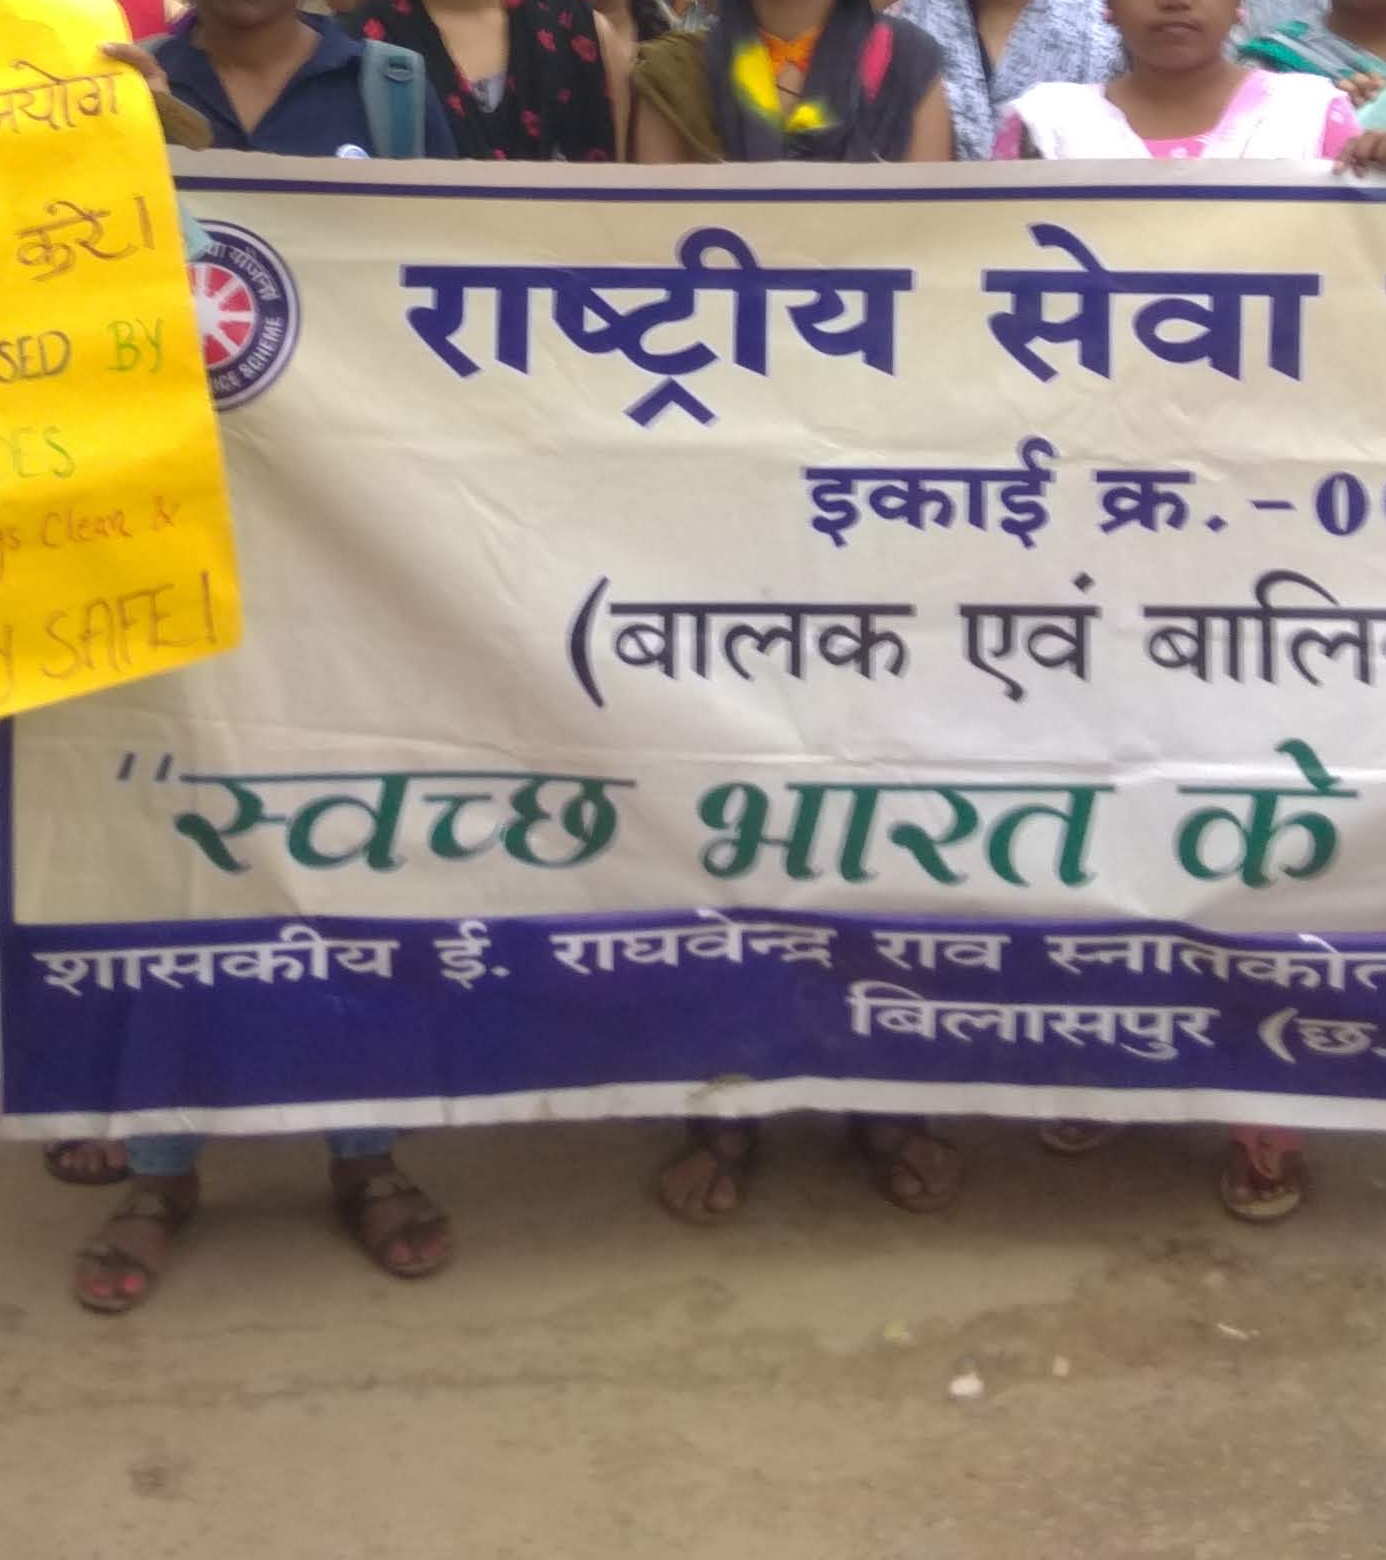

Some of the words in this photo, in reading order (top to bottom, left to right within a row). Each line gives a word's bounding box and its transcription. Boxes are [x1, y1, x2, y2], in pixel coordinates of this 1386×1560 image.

[107, 318, 166, 373] BY
[239, 315, 283, 380] SCHEME
[400, 225, 914, 426] राष्ट्रीय
[983, 222, 1322, 382] सेवा
[41, 509, 132, 549] Clean
[804, 436, 1058, 549] इकाई
[568, 576, 916, 709] (बालक
[959, 573, 1100, 702] एवं
[696, 780, 1116, 887] भारत
[1175, 737, 1359, 890] के
[34, 924, 399, 997] शासकीय
[433, 920, 509, 990] ई.
[549, 909, 836, 973] राघवेन्द्र
[872, 931, 1012, 974] राव
[848, 980, 1221, 1061] बिलासपुर
